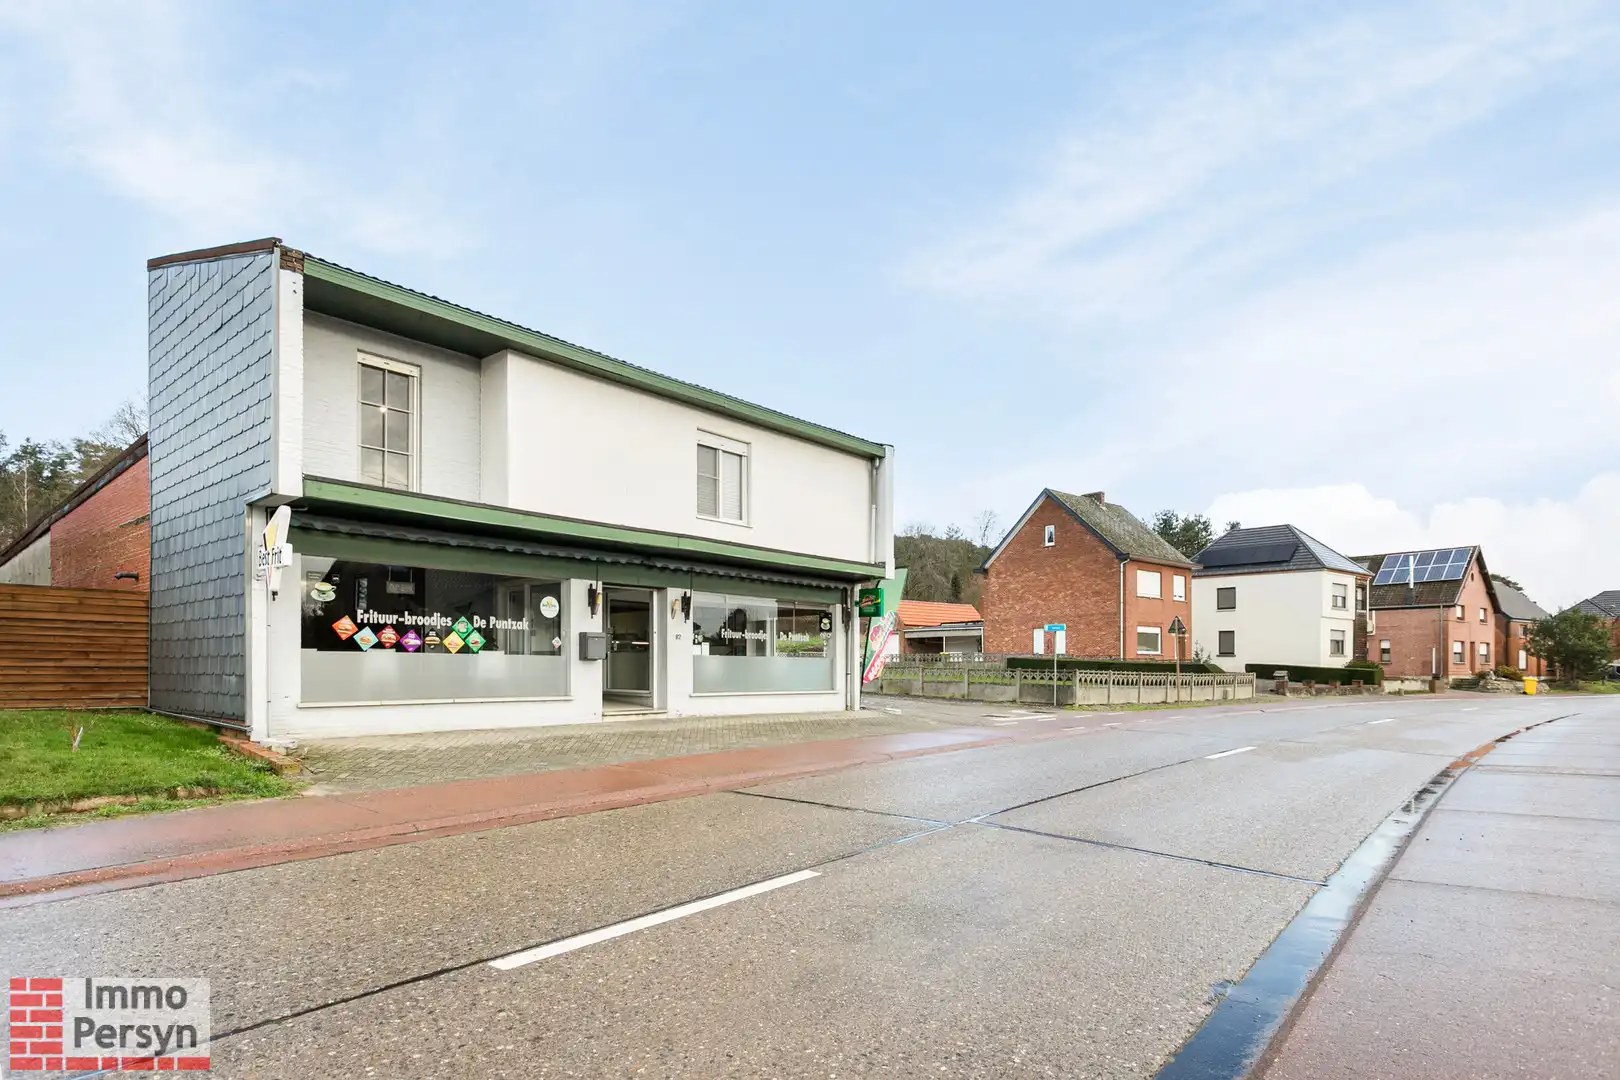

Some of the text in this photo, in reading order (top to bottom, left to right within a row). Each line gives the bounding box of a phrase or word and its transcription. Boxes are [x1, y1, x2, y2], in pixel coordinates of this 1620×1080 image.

[258, 546, 282, 567] Best Frit
[357, 609, 529, 631] Frituur-broodjes De Puntzak
